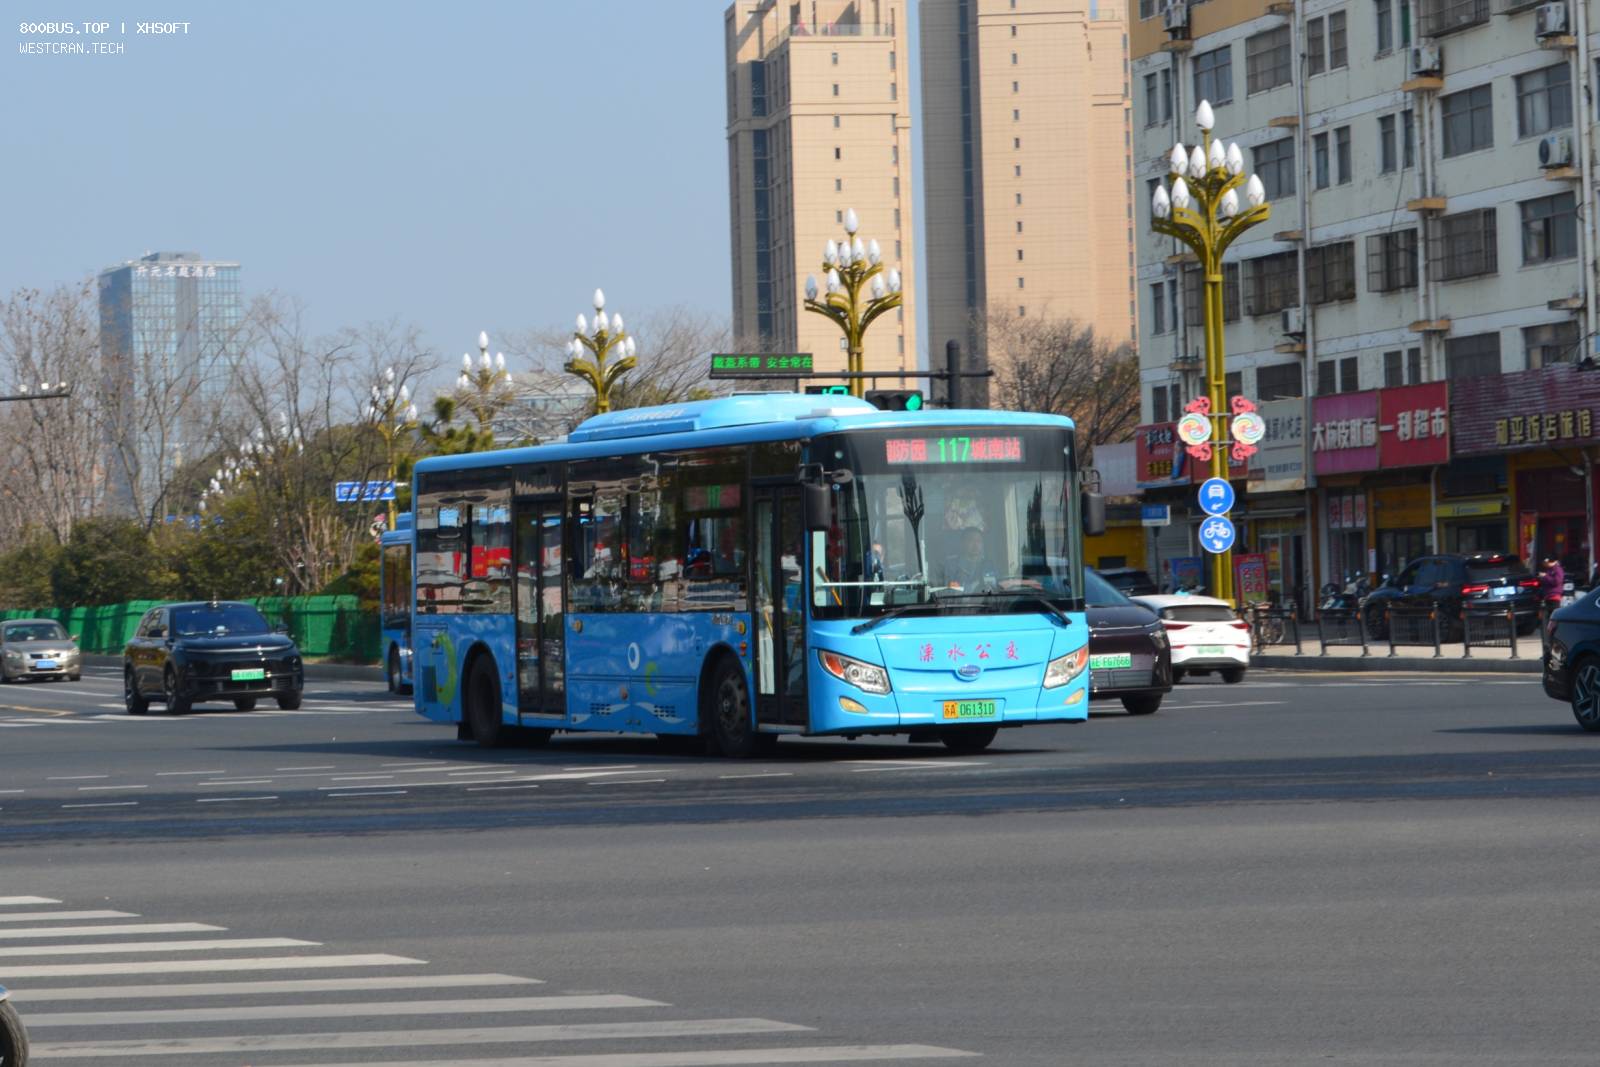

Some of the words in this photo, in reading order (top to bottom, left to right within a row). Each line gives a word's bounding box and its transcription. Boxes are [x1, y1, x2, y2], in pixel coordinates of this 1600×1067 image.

[1495, 409, 1592, 445] 和平饭店旅馆
[937, 437, 971, 463] 117
[919, 640, 1019, 662] 溧水公交
